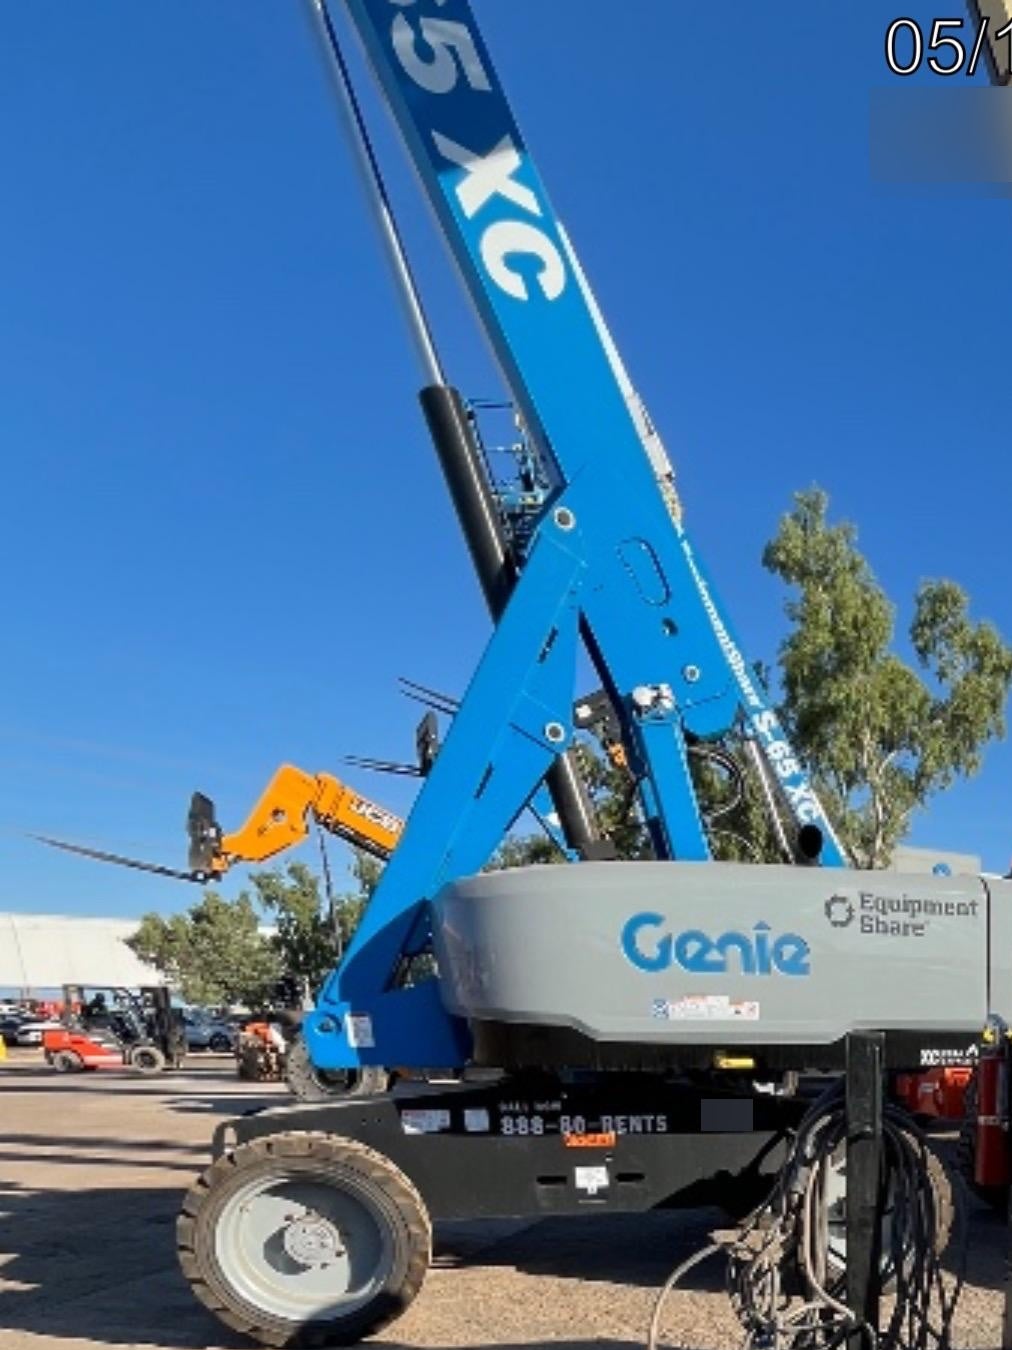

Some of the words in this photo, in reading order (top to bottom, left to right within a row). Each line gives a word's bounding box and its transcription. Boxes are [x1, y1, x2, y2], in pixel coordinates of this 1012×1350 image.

[389, 0, 493, 94] 5
[431, 129, 566, 301] XC
[859, 891, 979, 920] Equipment
[859, 914, 926, 937] Share
[621, 911, 811, 976] Genie
